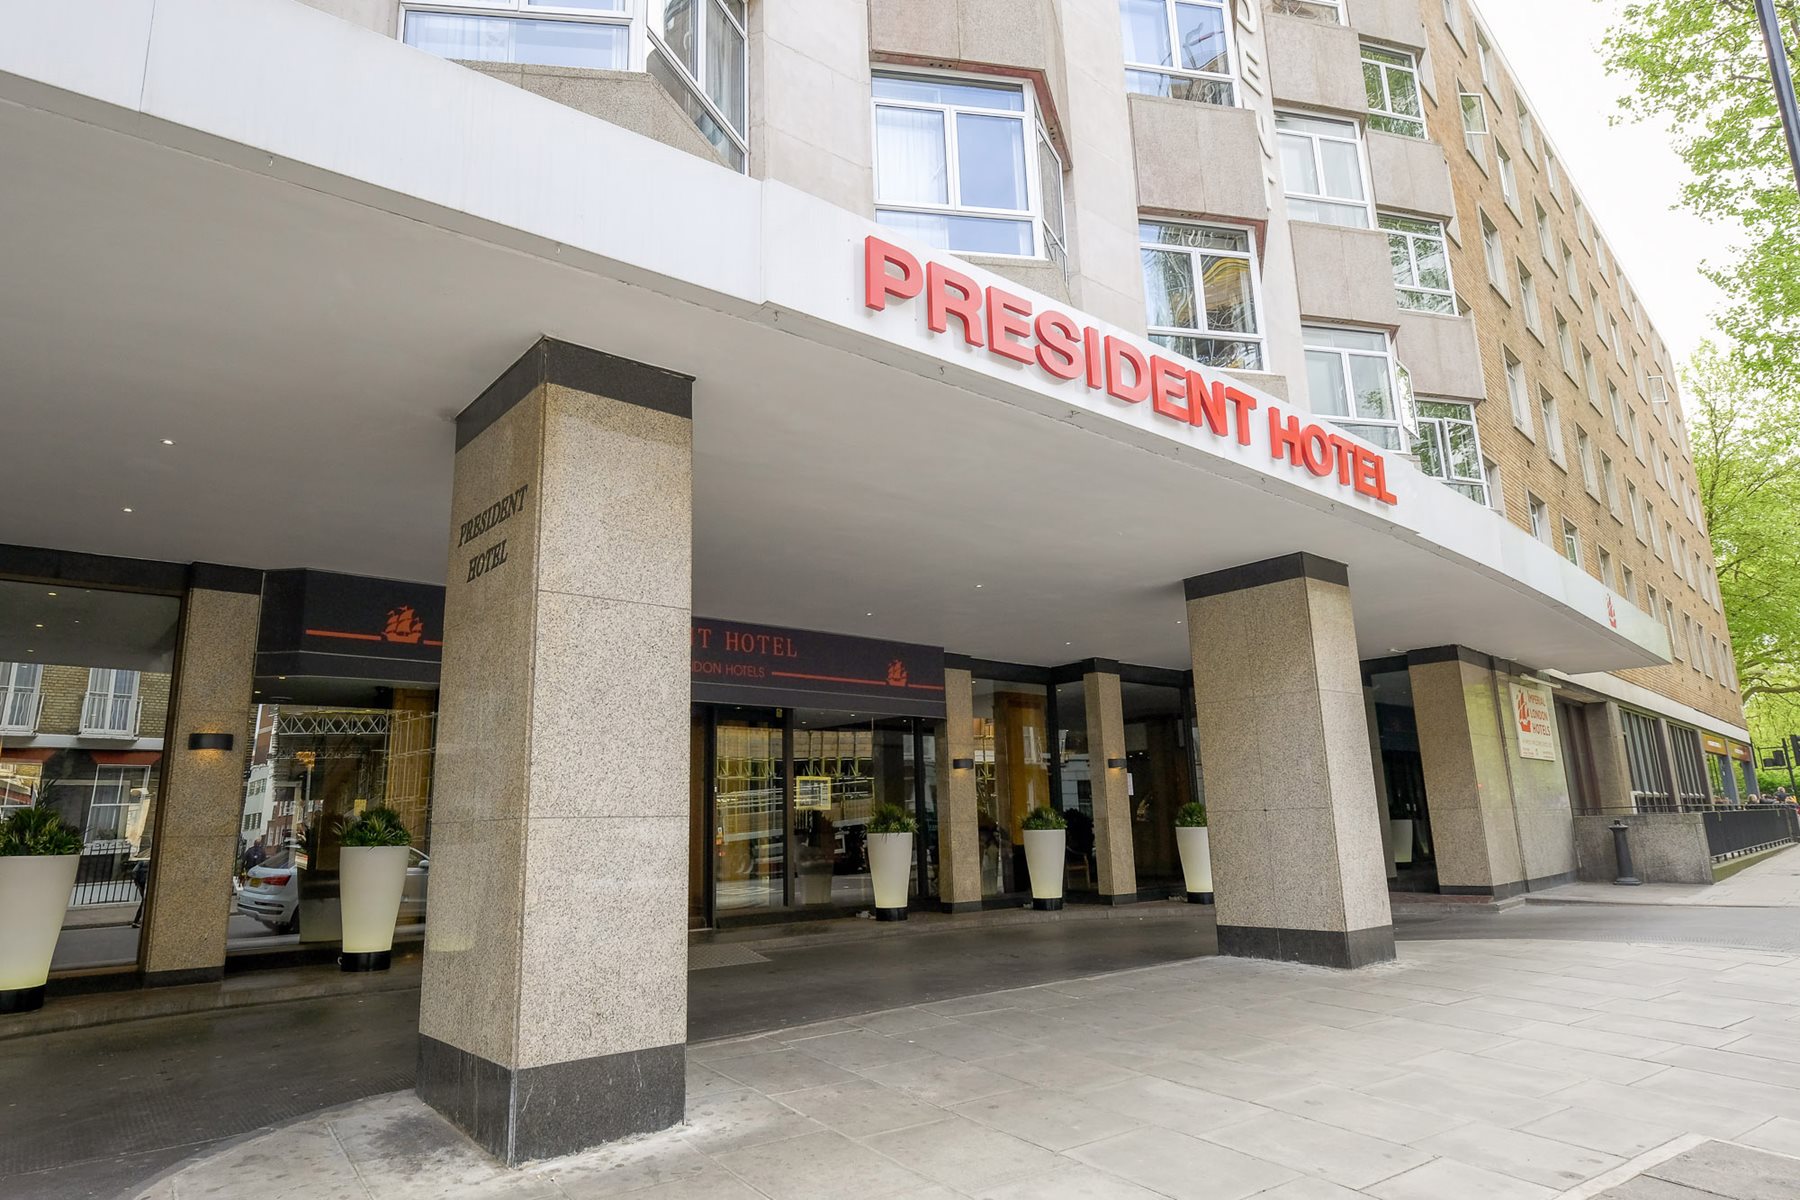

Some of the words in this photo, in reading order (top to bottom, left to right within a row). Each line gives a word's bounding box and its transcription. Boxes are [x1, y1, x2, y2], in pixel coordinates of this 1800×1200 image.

[865, 235, 1256, 446] PRESIDENT
[1268, 406, 1398, 506] HOTEL
[458, 484, 528, 548] PRESIDENT
[467, 539, 509, 583] HOTEL
[724, 631, 798, 657] HOTEL
[691, 660, 721, 675] DON
[725, 664, 766, 679] HOTELS
[1530, 708, 1549, 721] LONDON
[1533, 723, 1551, 736] HOTELS
